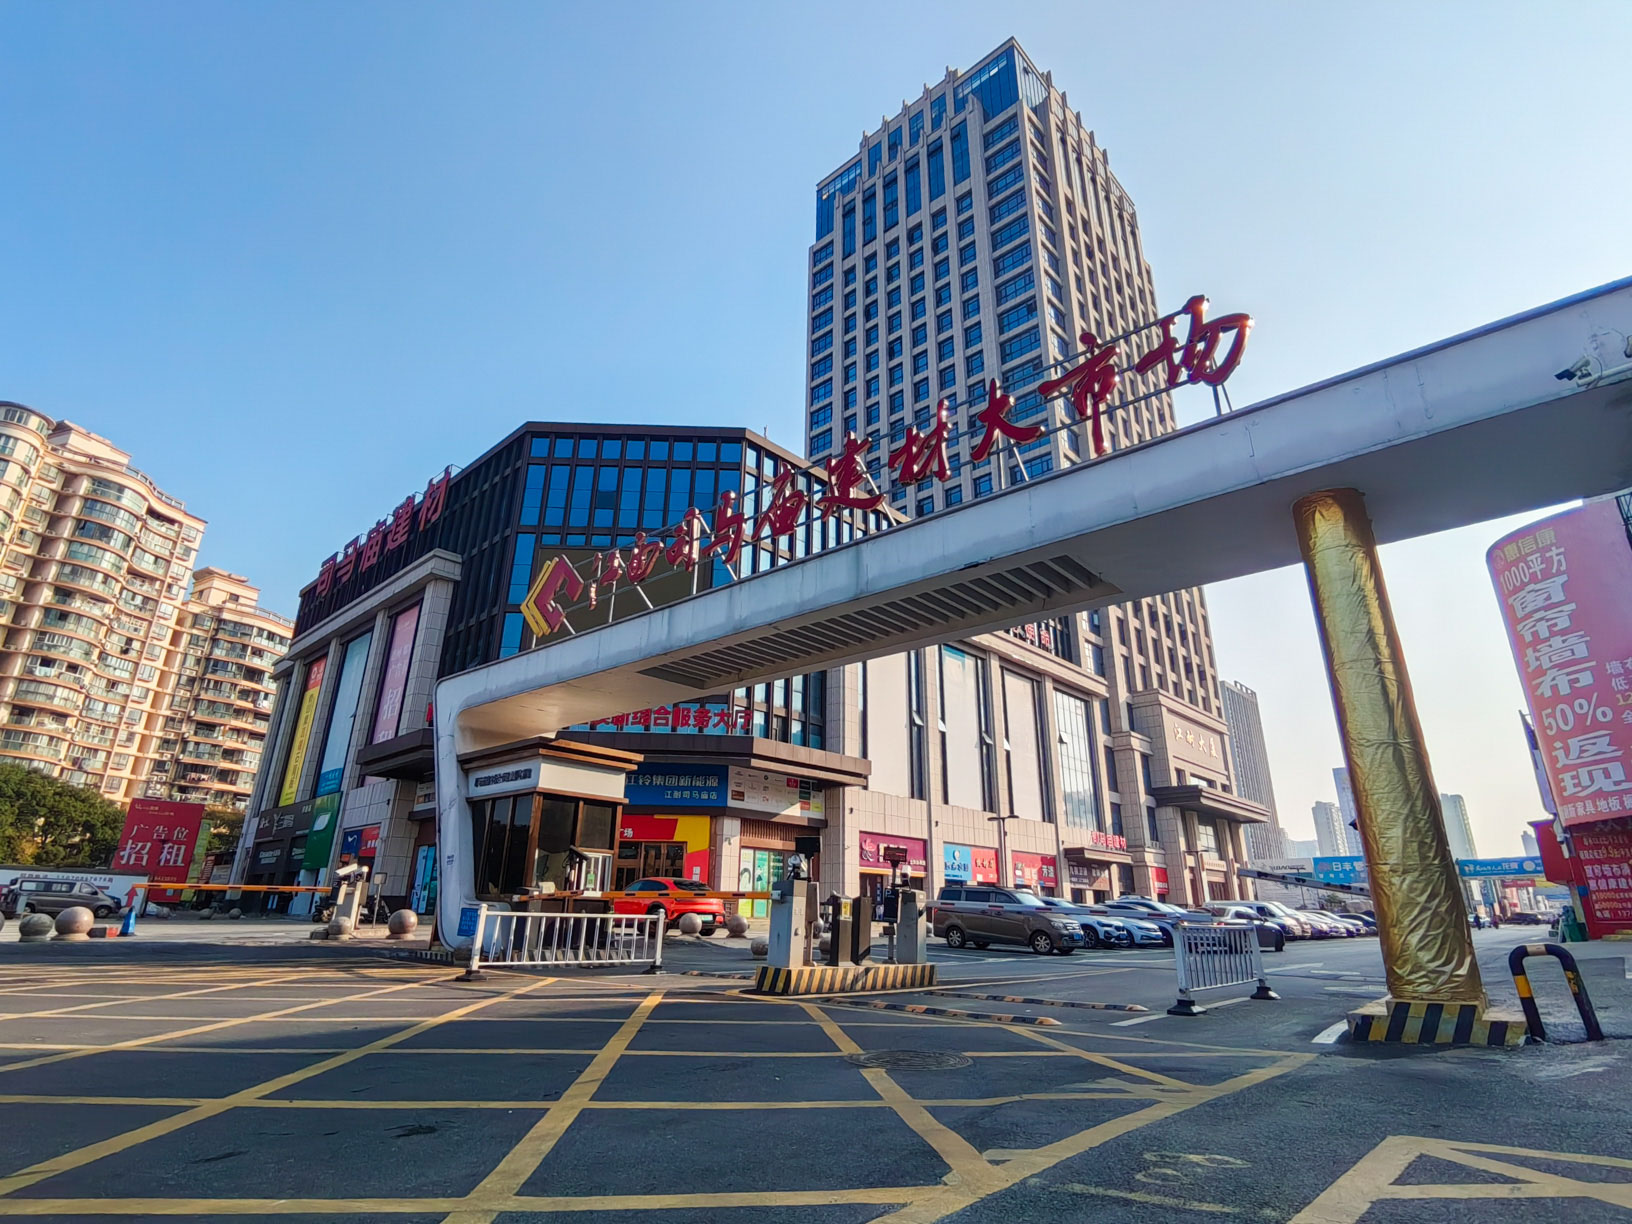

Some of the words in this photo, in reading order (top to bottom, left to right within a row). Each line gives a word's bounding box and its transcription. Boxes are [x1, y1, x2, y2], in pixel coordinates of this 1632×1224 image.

[1500, 546, 1567, 594] 1000平方
[1507, 574, 1597, 698] 窗帘墙布
[1541, 692, 1613, 736] 50%
[627, 774, 719, 787] 江铃集团新能源
[1552, 730, 1632, 797] 返现
[120, 839, 186, 867] 招租
[129, 824, 189, 841] 广告位
